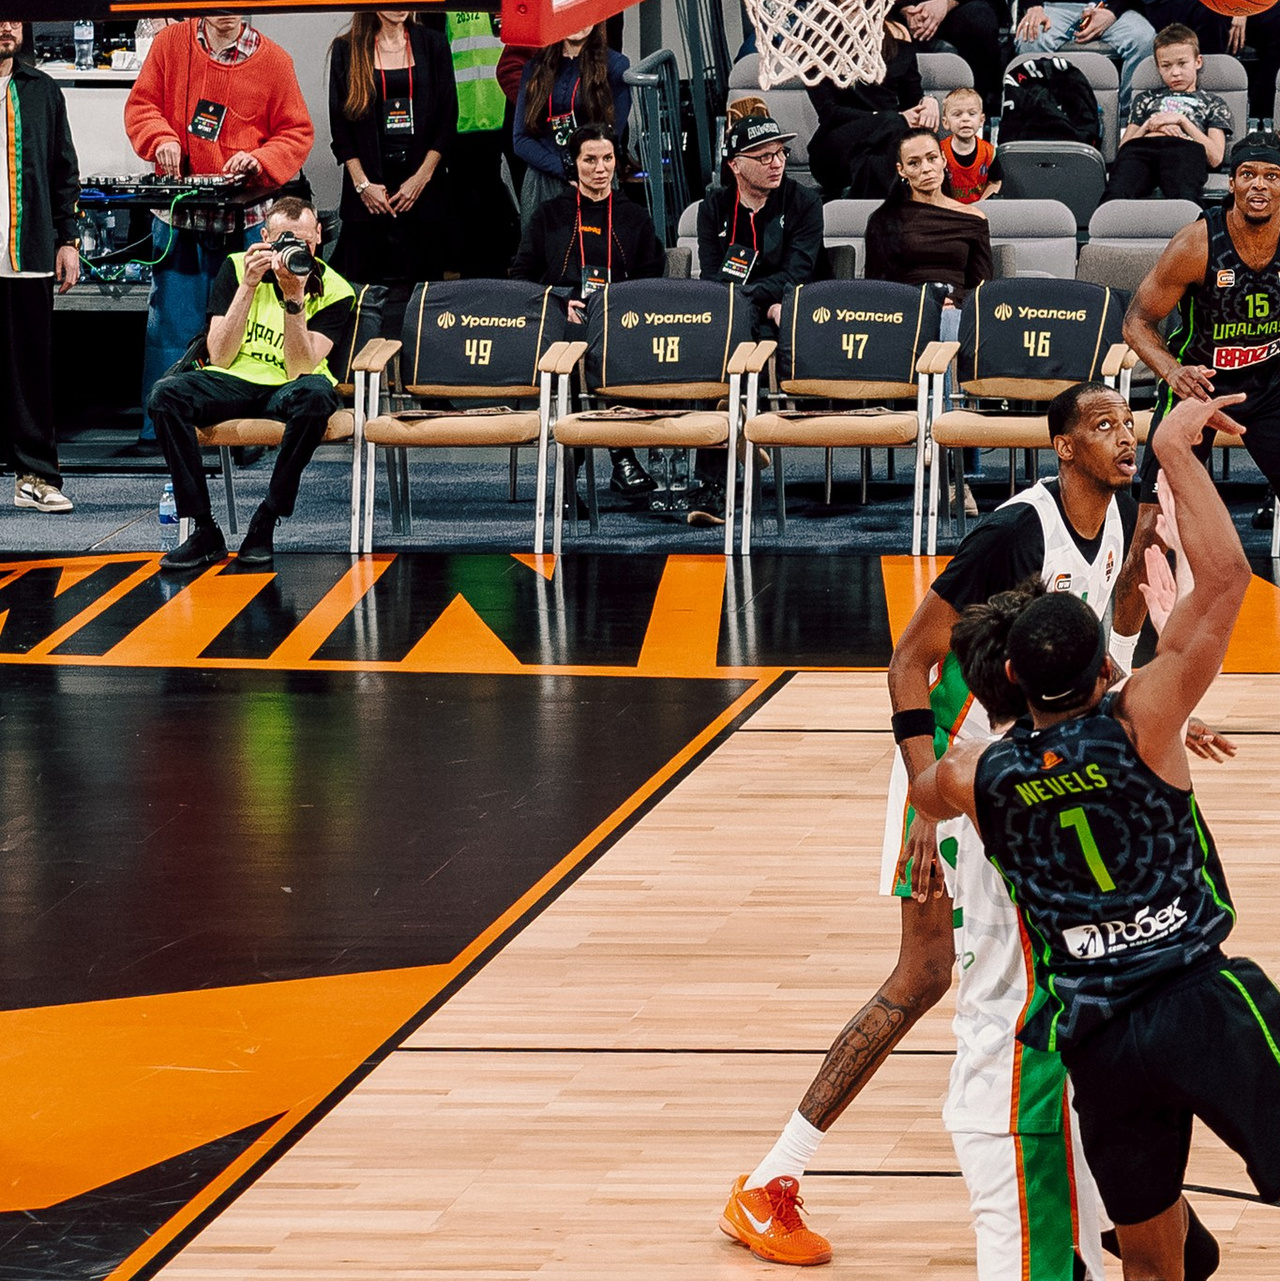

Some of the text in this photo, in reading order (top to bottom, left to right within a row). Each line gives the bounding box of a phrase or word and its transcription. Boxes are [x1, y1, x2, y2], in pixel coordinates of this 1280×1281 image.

[645, 311, 712, 325] Уралсиб
[836, 308, 904, 325] Уралсиб
[1018, 305, 1087, 322] Уралсиб
[1245, 293, 1270, 319] 15
[461, 314, 526, 329] Уралсиб
[465, 339, 493, 366] 49
[652, 336, 680, 363] 48
[841, 333, 869, 360] 47
[1023, 331, 1051, 358] 46
[1015, 763, 1108, 806] NEVELS
[1059, 806, 1117, 893] 1
[1101, 896, 1187, 945] Робек
